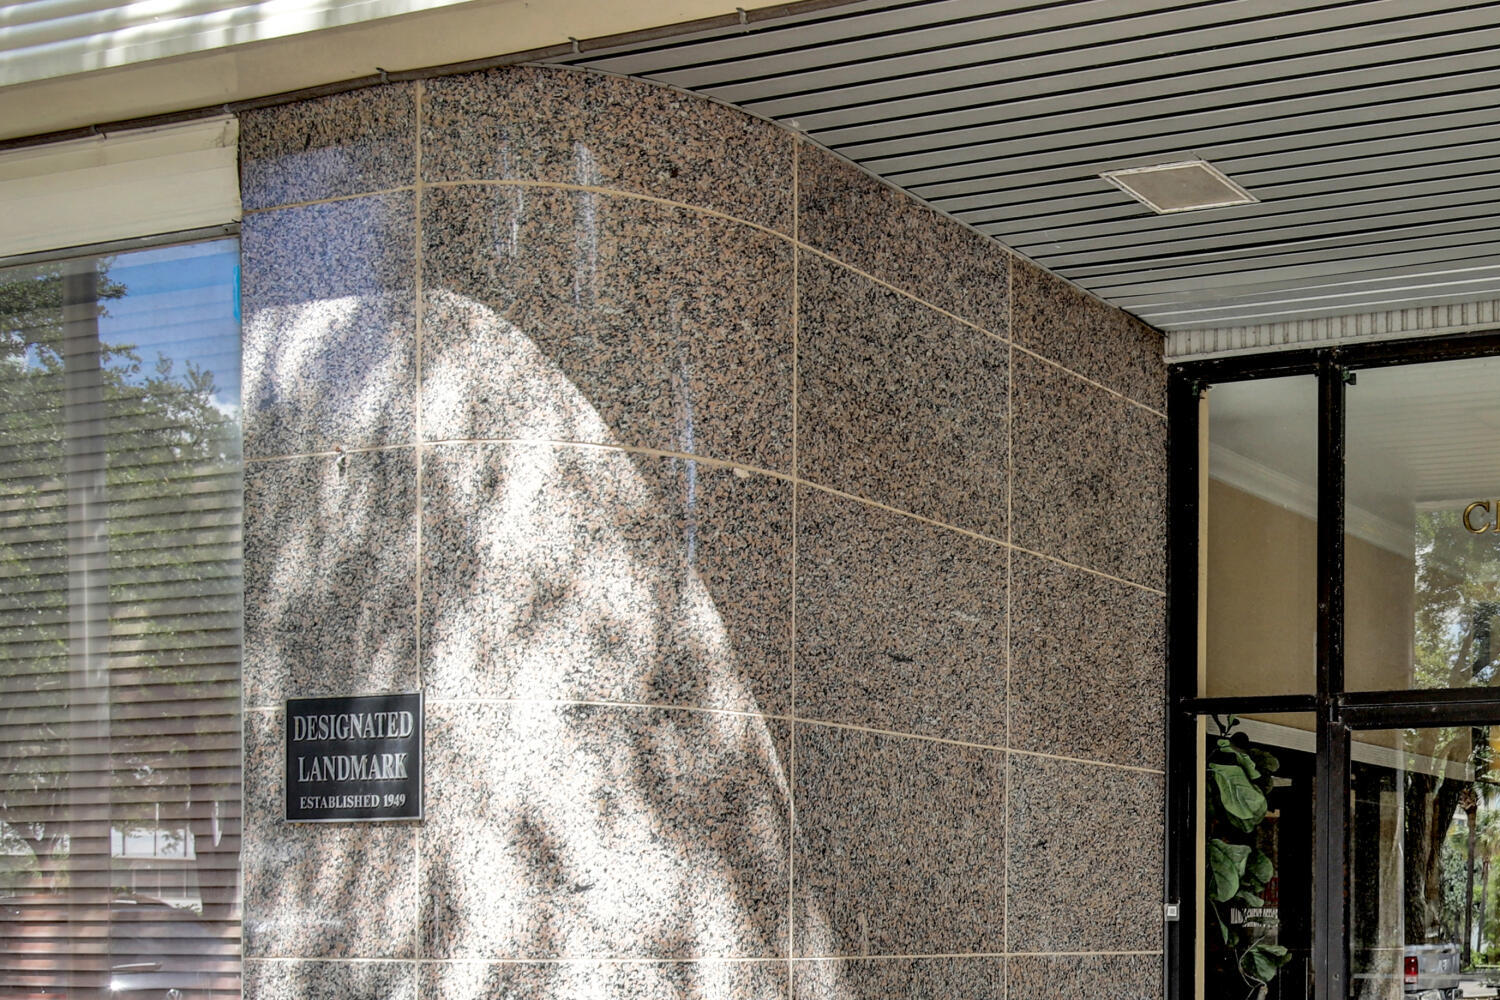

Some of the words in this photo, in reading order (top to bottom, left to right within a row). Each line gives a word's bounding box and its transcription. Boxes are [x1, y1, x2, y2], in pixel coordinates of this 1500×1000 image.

[293, 711, 414, 741] DESIGNATED
[298, 753, 408, 782] LANDMARK
[300, 794, 380, 809] ESTABLISHED
[383, 793, 406, 807] 1949
